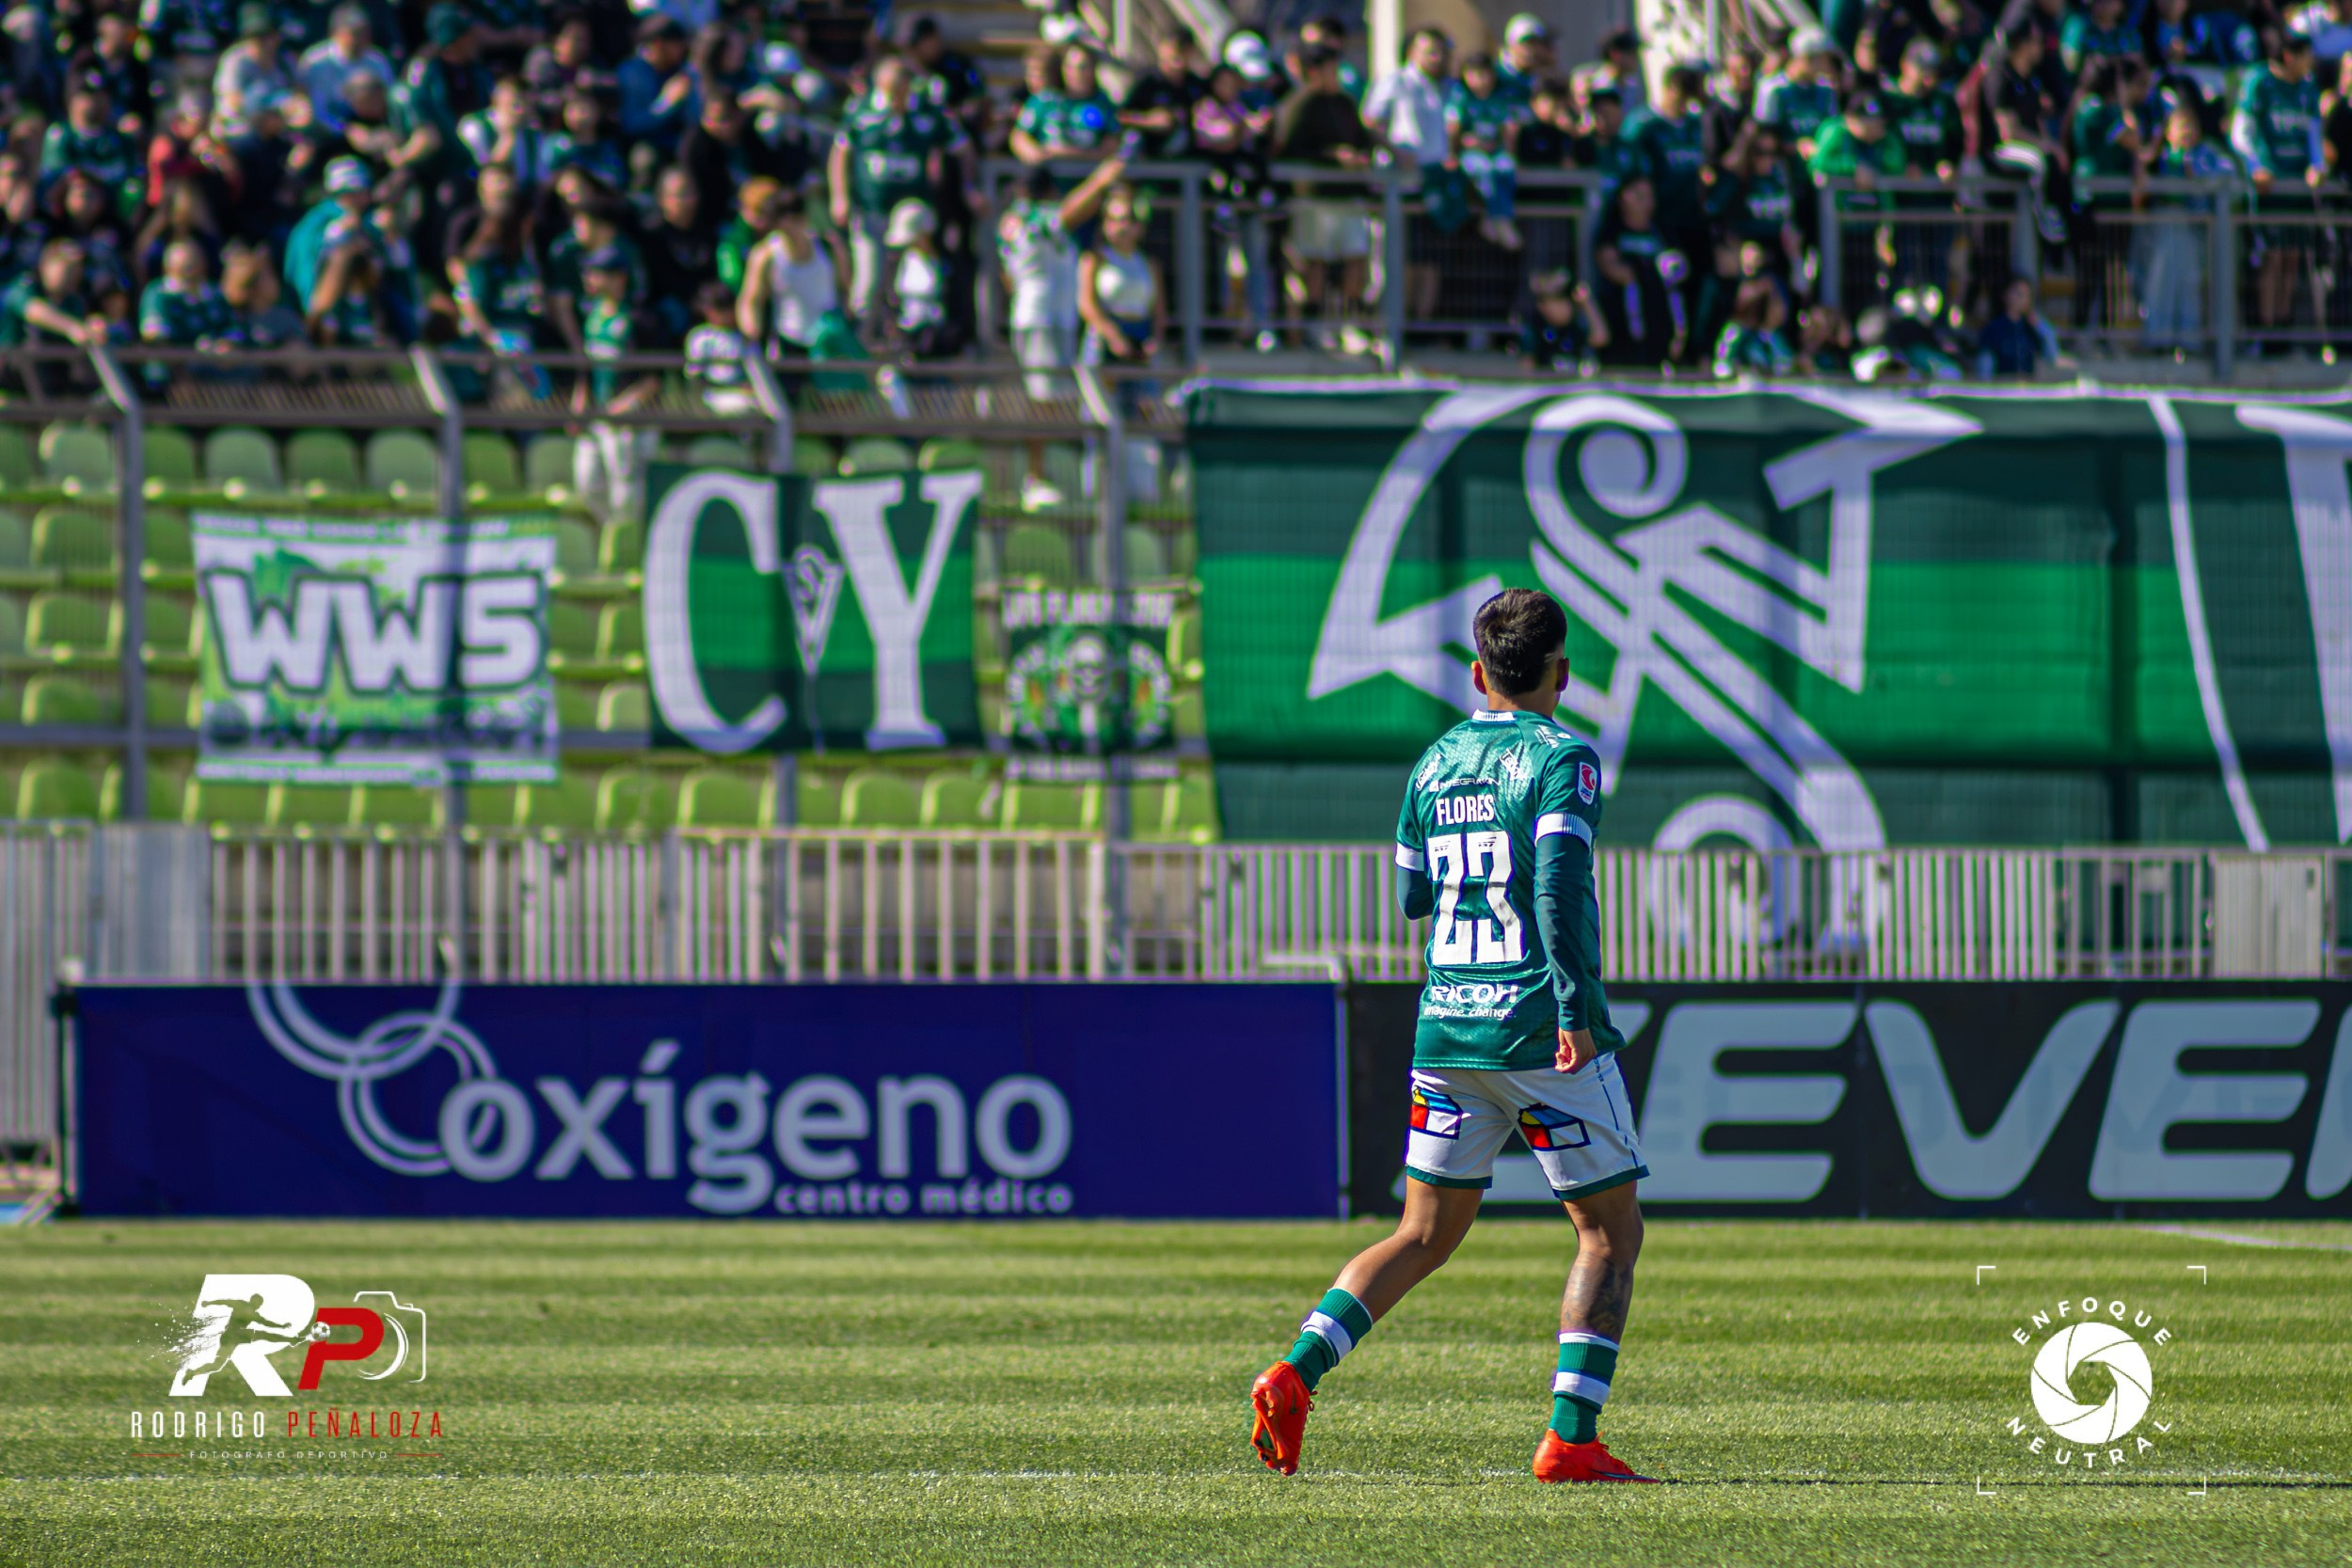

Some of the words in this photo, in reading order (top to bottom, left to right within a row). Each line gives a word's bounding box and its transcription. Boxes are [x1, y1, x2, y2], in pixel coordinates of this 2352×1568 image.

[203, 568, 547, 695] WWS
[1436, 793, 1495, 827] FLORES
[1427, 830, 1523, 967] 23
[1430, 983, 1519, 1004] RICOH
[438, 1039, 1073, 1214] oxígeno
[1391, 1000, 2352, 1202] EVE
[774, 1181, 911, 1214] centro
[920, 1176, 1074, 1214] médico
